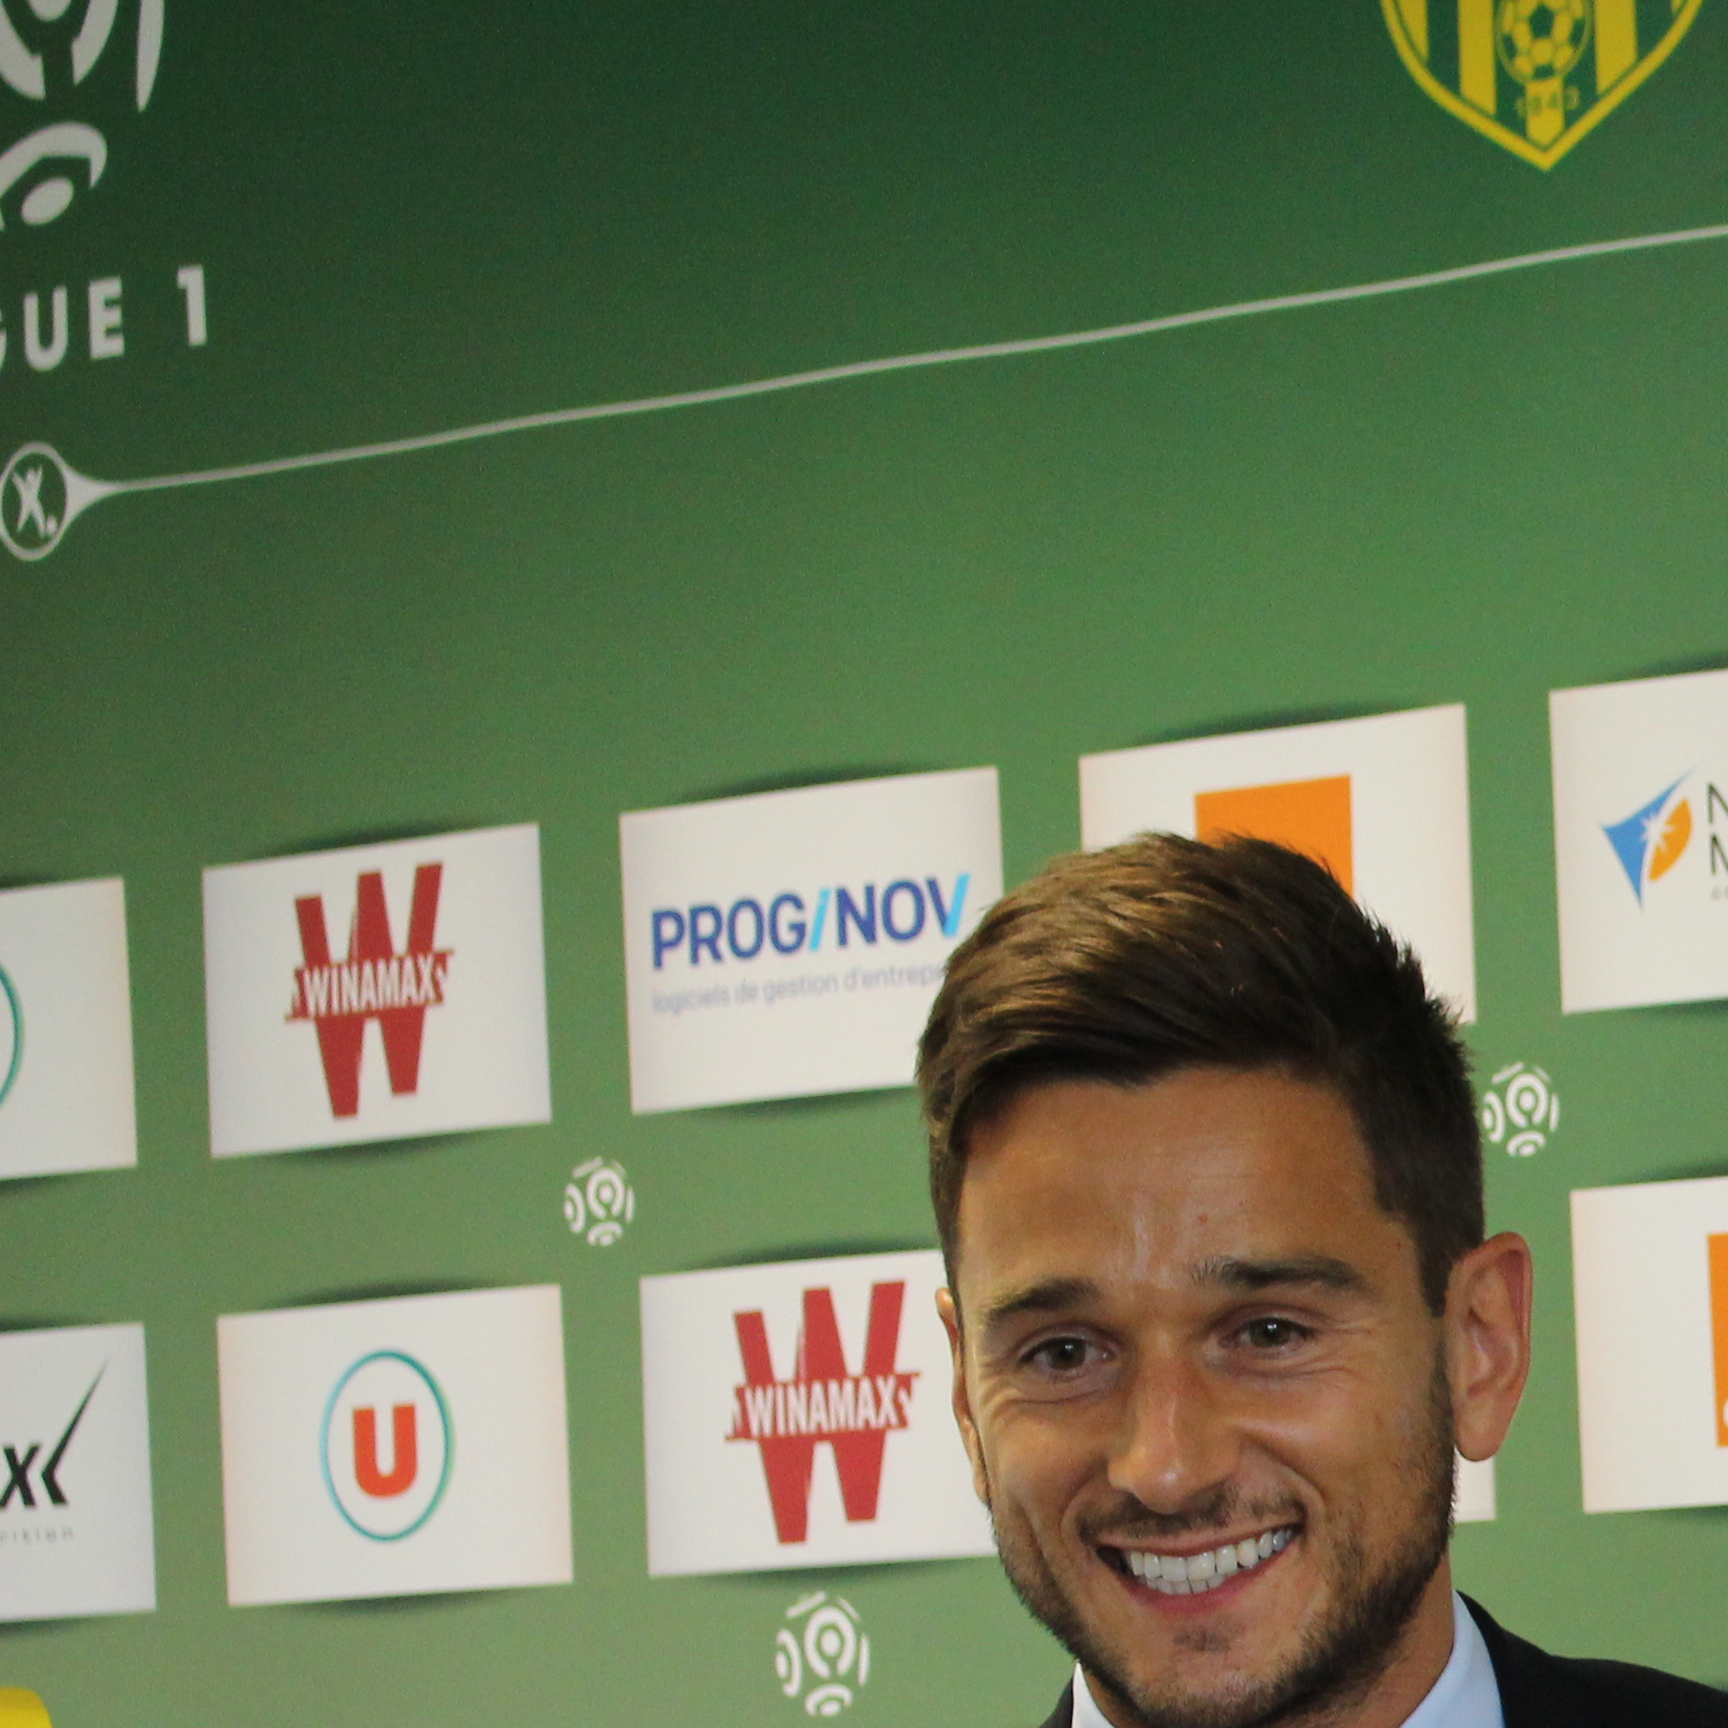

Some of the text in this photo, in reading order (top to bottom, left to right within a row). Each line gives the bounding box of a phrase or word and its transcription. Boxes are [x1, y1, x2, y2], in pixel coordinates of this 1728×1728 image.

[177, 264, 208, 346] 1
[303, 954, 437, 1017] WINAMAX
[735, 975, 757, 1006] de
[763, 971, 839, 1009] gestion
[744, 1375, 899, 1438] WINAMAX
[351, 1403, 420, 1499] U
